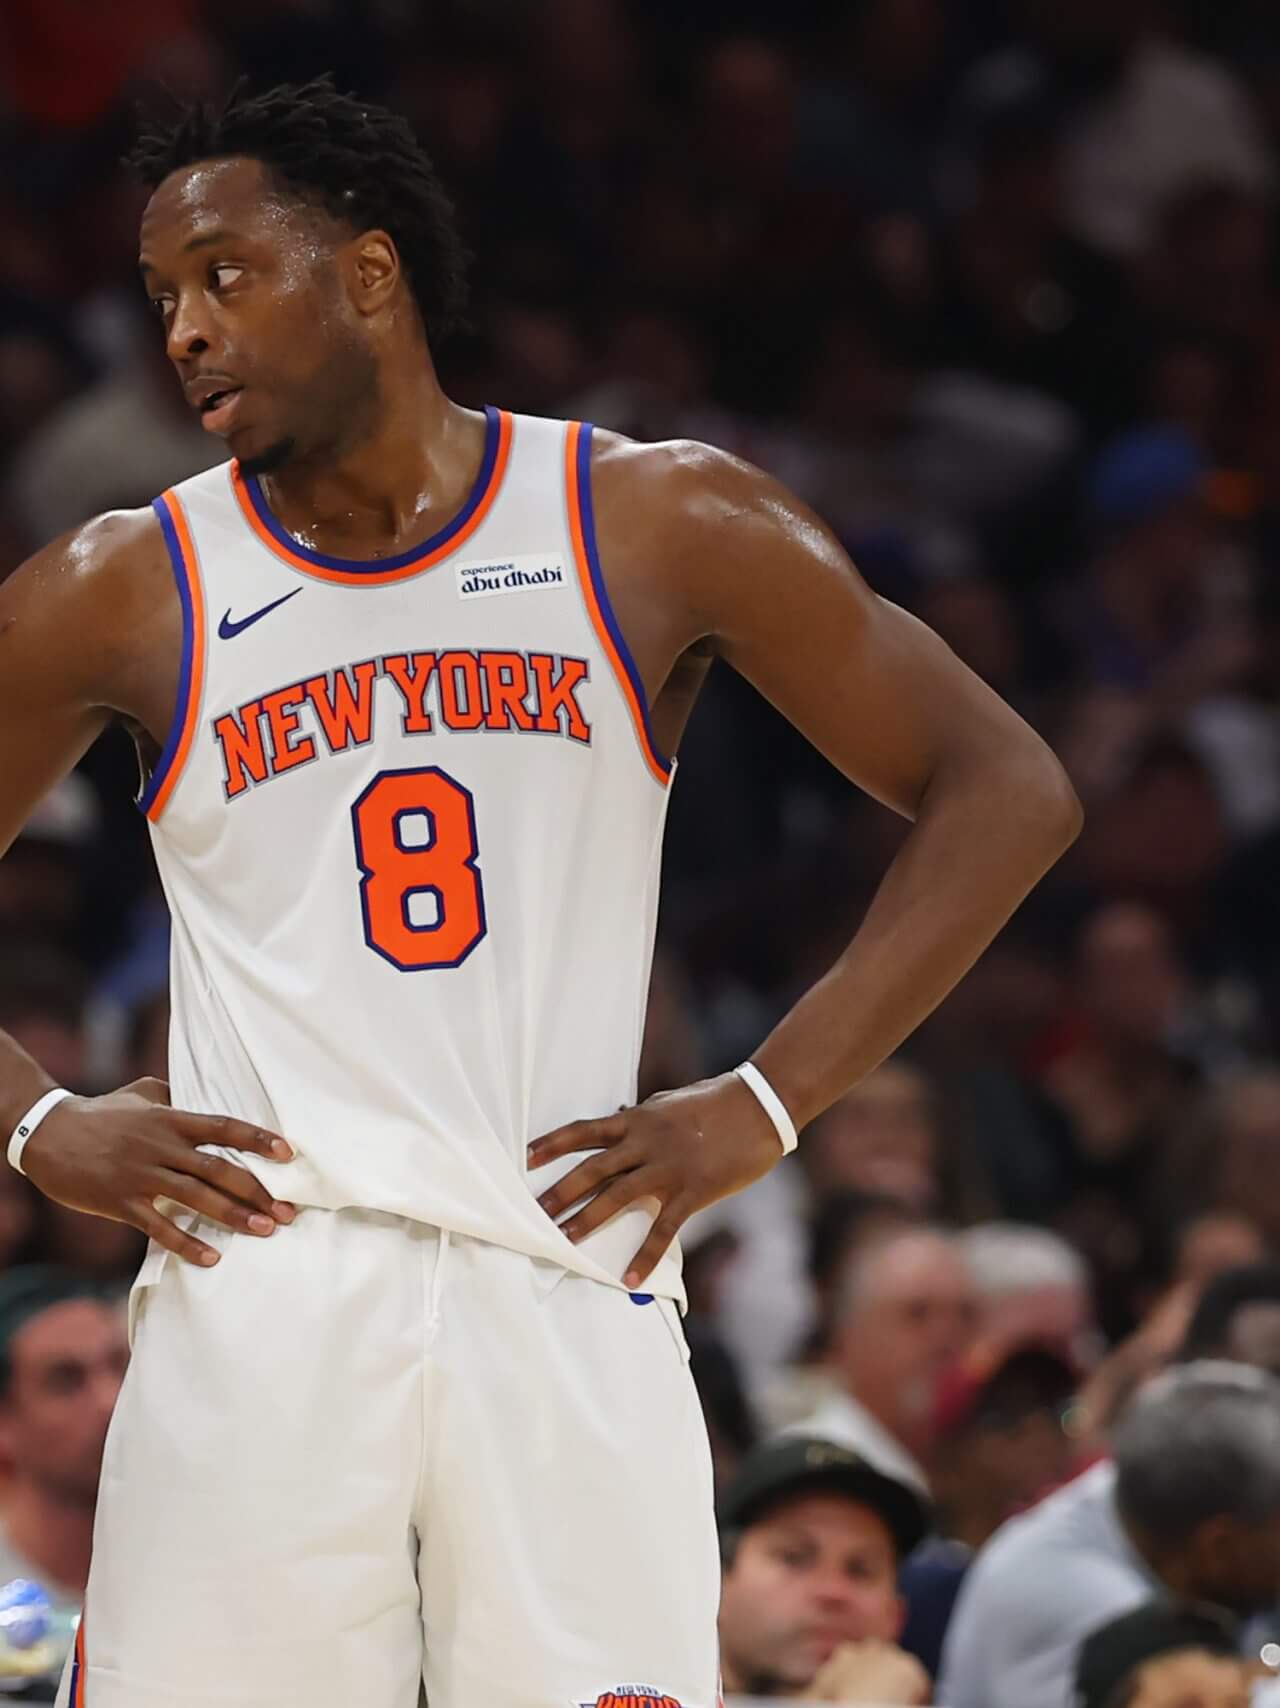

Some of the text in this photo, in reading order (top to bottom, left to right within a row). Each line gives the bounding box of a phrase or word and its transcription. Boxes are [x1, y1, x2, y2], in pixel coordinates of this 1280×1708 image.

[461, 563, 515, 576] experience
[461, 566, 563, 593] abu dhabi
[214, 647, 593, 804] NEW YORK
[351, 766, 487, 972] 8
[18, 1125, 29, 1137] 8
